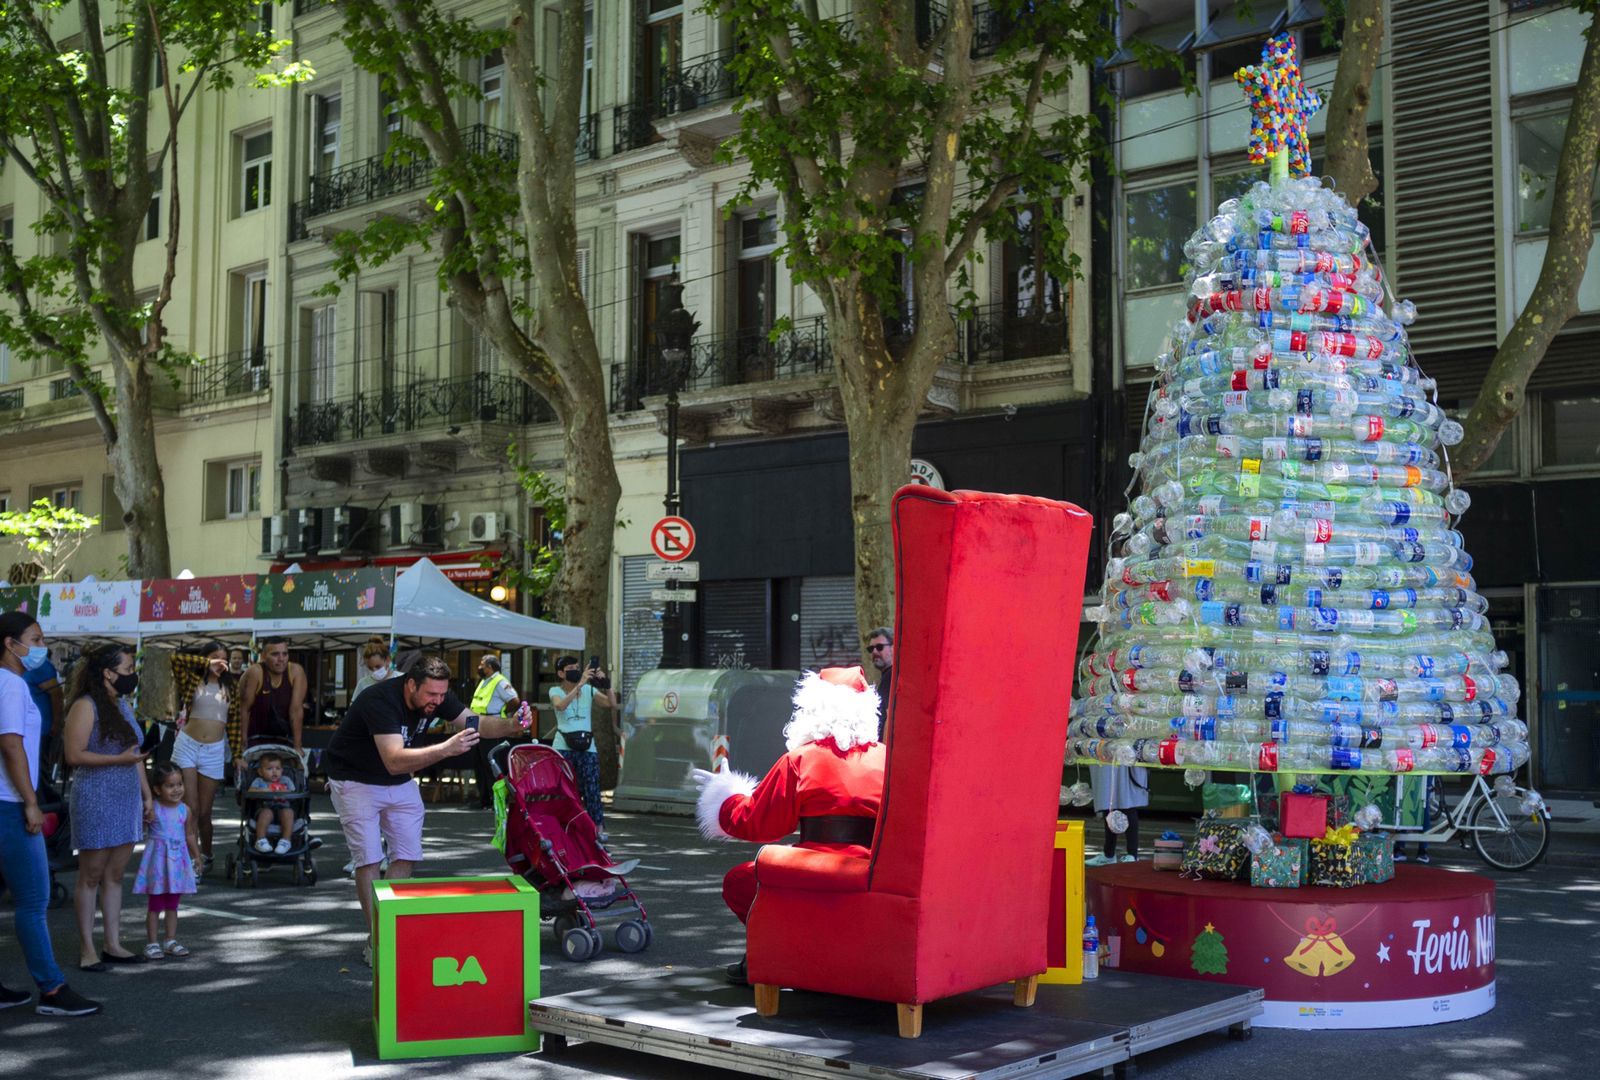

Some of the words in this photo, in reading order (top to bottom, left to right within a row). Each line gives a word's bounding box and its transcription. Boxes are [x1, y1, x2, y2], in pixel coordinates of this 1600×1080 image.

[188, 586, 202, 601] Feria
[313, 580, 329, 596] Feria
[180, 598, 209, 614] NAVIDEÑA
[303, 593, 337, 611] NAVIDEÑA
[1407, 915, 1471, 975] Feria
[433, 956, 487, 986] BA
